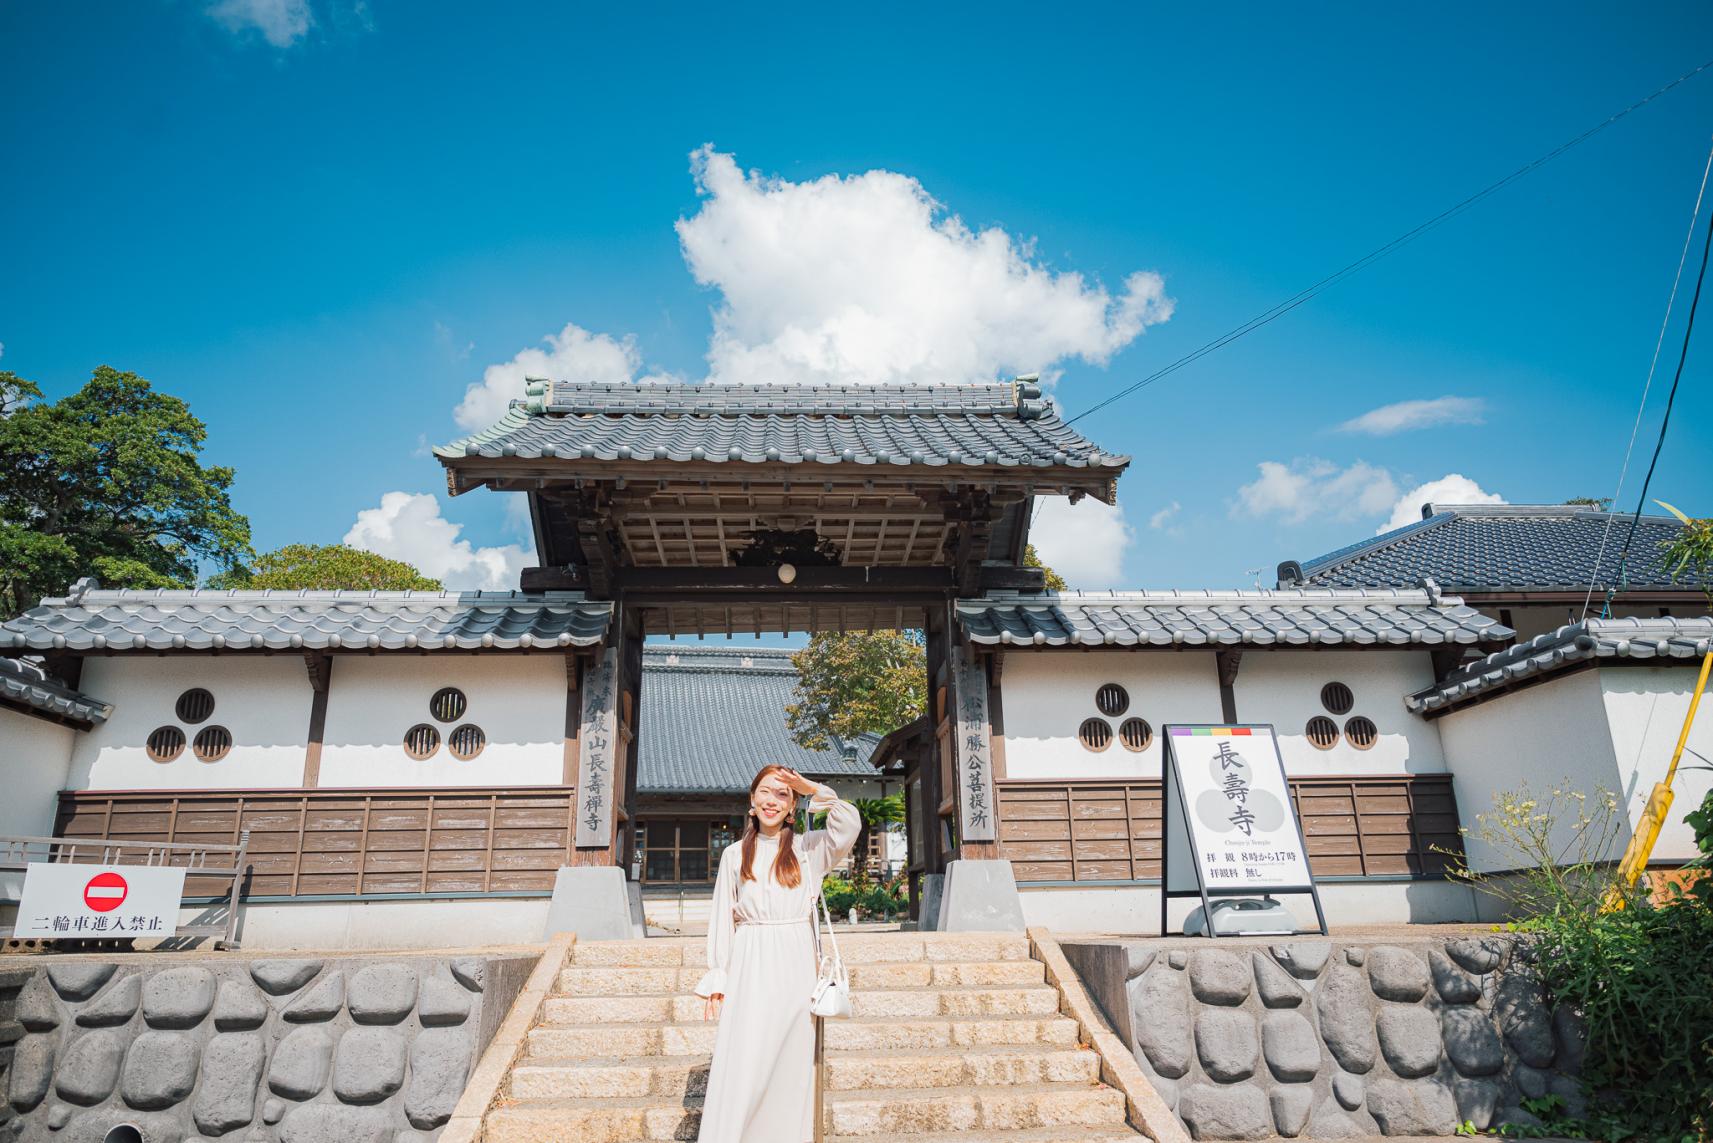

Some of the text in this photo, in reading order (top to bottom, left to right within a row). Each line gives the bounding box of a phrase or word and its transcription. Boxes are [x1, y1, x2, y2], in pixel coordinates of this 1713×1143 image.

[961, 696, 988, 829] 松浦勝公菩提所
[1213, 741, 1255, 836] 長壽寺
[32, 915, 162, 932] 二輪車進入禁止
